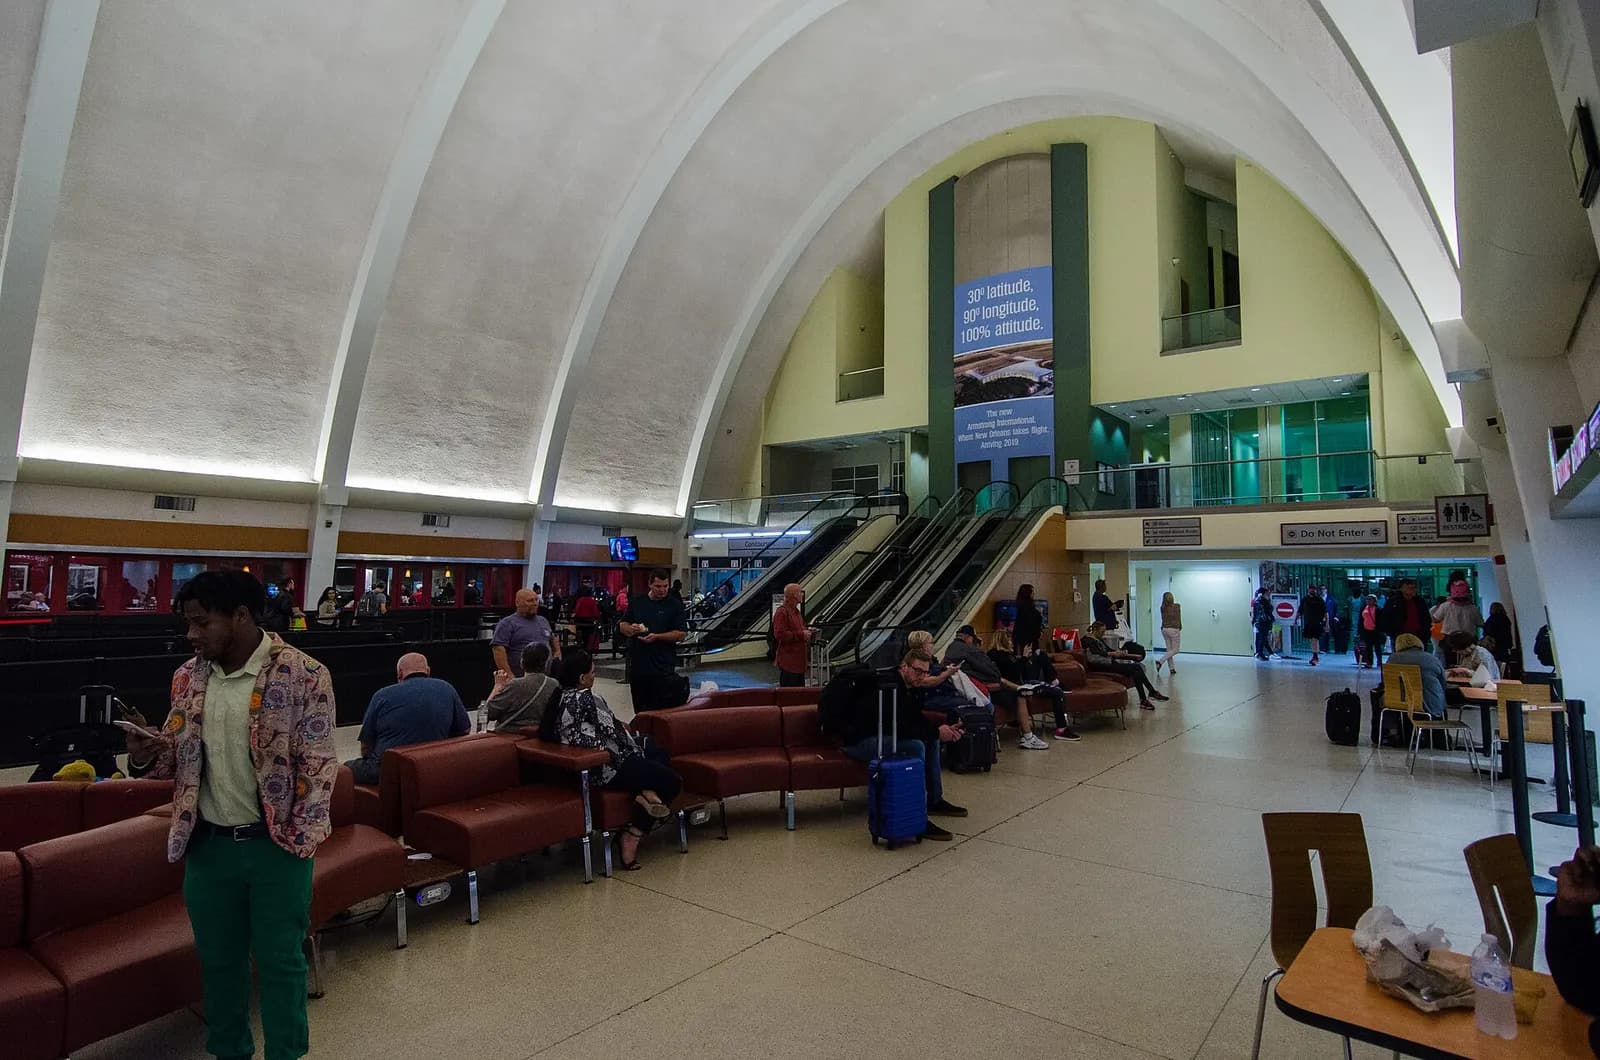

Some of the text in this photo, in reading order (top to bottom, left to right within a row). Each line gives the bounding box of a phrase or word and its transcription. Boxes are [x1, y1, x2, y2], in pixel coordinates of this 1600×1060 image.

[987, 278, 1034, 300] latitude,
[961, 316, 1045, 344] 100% attitude.
[986, 408, 1013, 418] The new
[975, 431, 988, 440] New
[989, 429, 1011, 439] Orleans
[1012, 426, 1030, 436] takes
[980, 440, 1003, 449] Arriving
[1300, 528, 1365, 538] Do Not Enter
